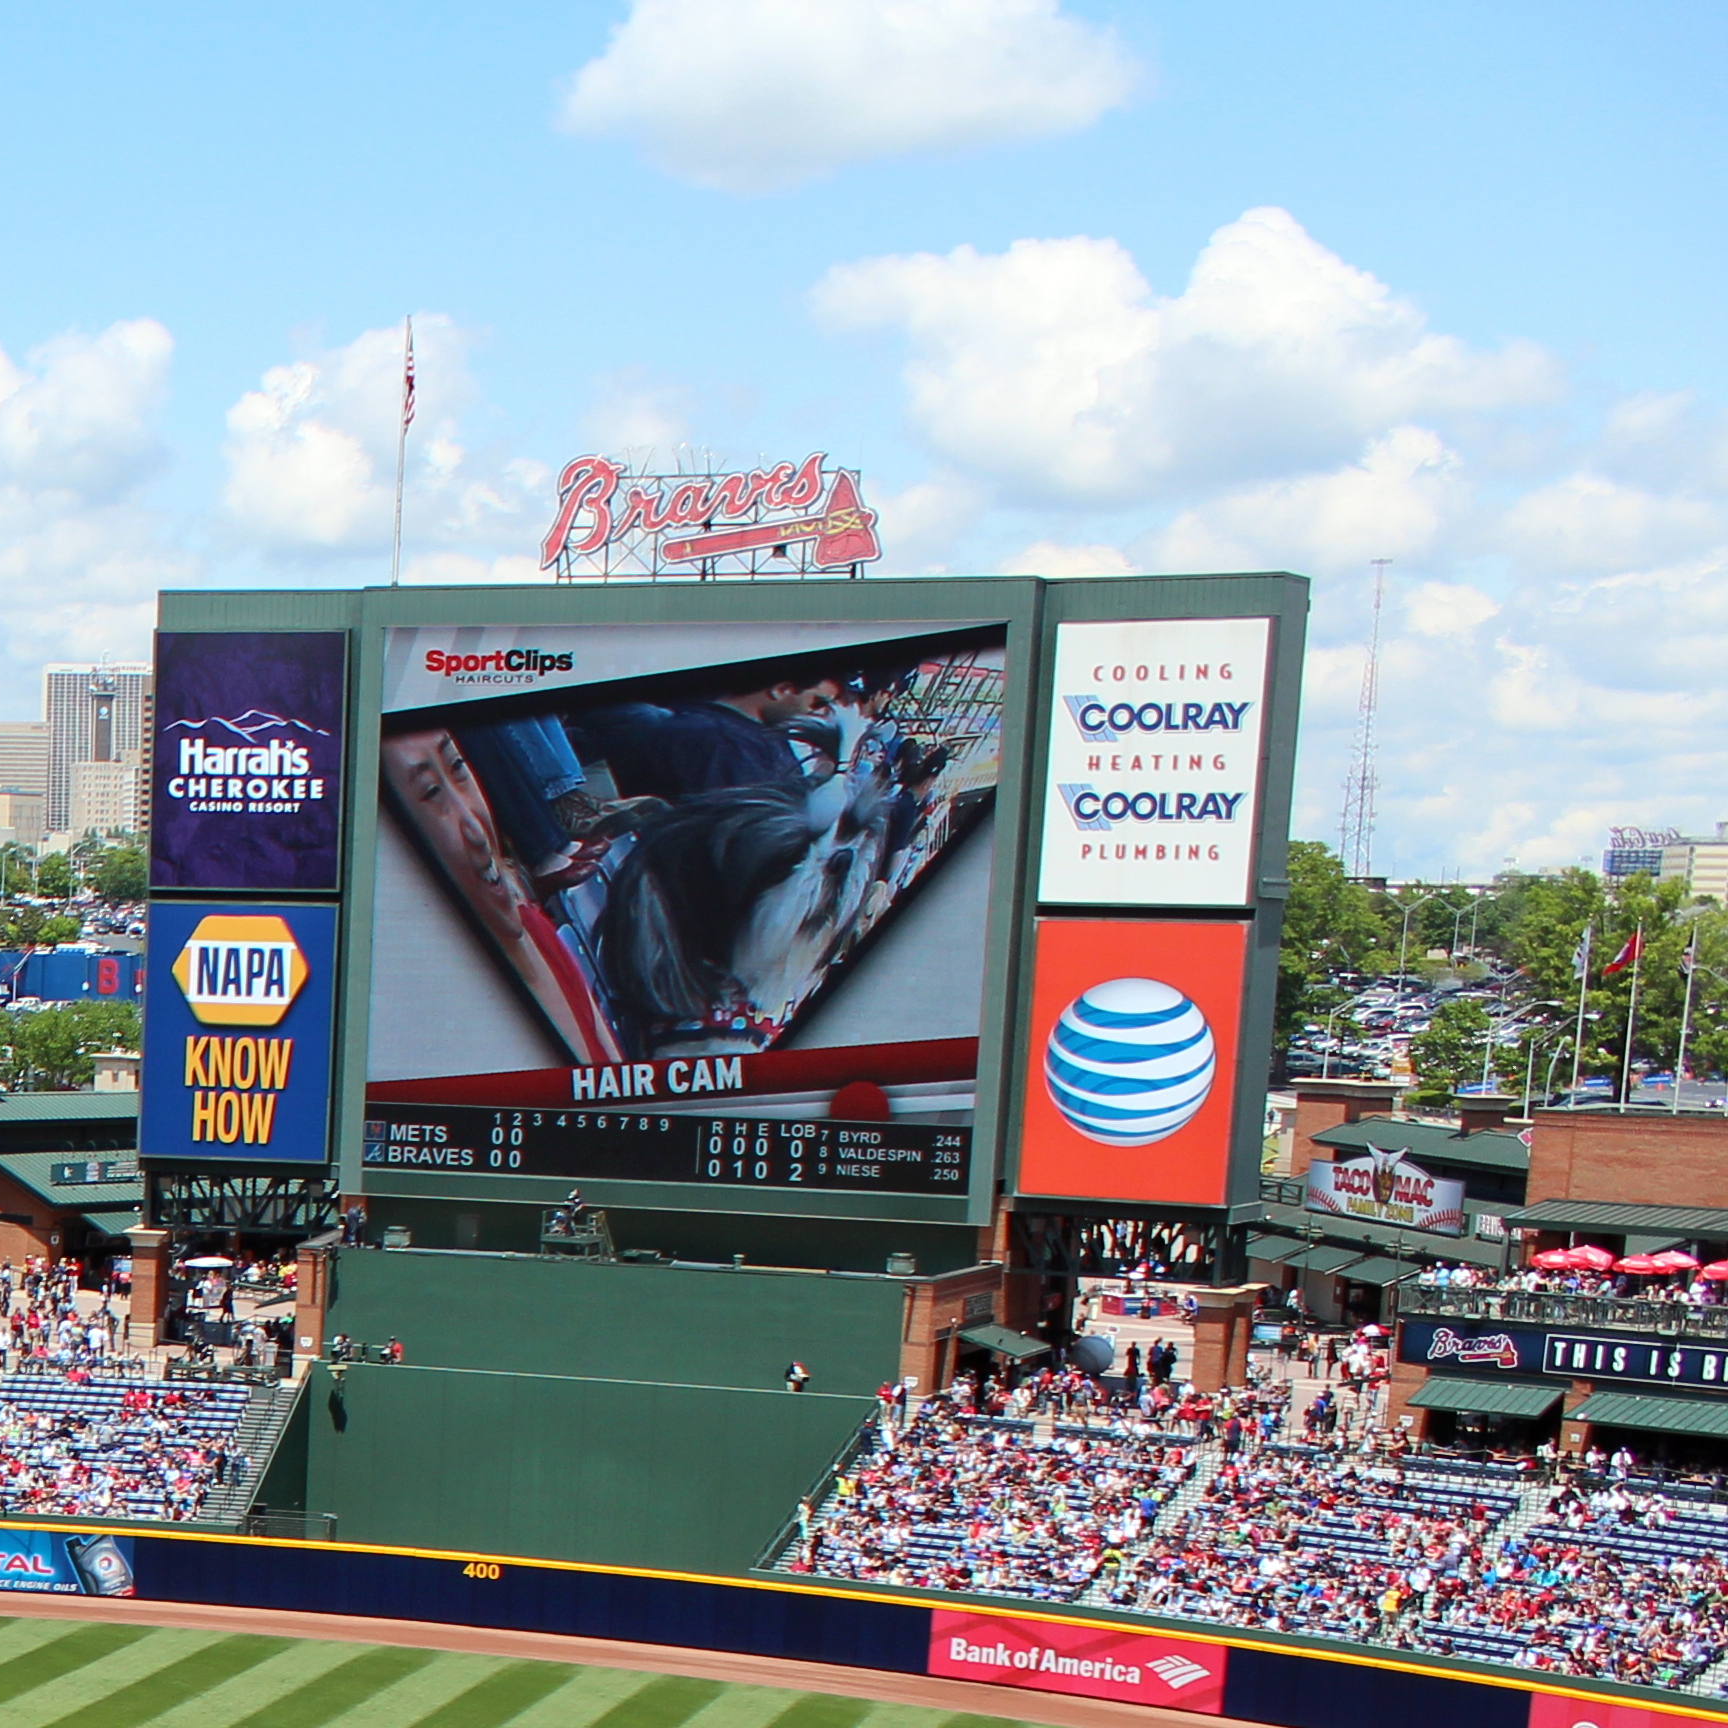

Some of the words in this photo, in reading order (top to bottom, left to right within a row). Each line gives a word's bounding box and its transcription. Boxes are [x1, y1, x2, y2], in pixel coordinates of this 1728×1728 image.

[540, 452, 828, 569] Braves
[425, 649, 574, 677] SportClips
[1092, 663, 1233, 682] COOLING
[455, 674, 534, 684] HAIRCUTS
[1079, 702, 1252, 732] COOLRAY
[179, 738, 311, 776] Harrah's
[1087, 754, 1226, 771] HEATING
[167, 777, 324, 800] CHEROKEE
[189, 801, 244, 813] CASINO
[248, 802, 301, 814] RESORT
[1073, 791, 1246, 821] COOLRAY
[1081, 843, 1220, 861] PLUMBING
[197, 946, 285, 998] NAPA
[184, 1035, 292, 1090] KNOW
[572, 1063, 656, 1101] HAIR
[667, 1056, 743, 1094] CAM
[192, 1091, 275, 1145] HOW
[712, 1121, 724, 1135] R
[735, 1122, 747, 1135] H
[758, 1123, 769, 1137] E
[780, 1123, 817, 1138] LOB
[390, 1123, 448, 1143] METS
[839, 1131, 882, 1144] BYRD
[931, 1135, 962, 1148] .244
[388, 1146, 474, 1166] BRAVES
[838, 1148, 922, 1163] VALDESPIN
[930, 1152, 961, 1164] .263
[836, 1164, 881, 1177] NIESE
[929, 1168, 960, 1180] .250
[1333, 1166, 1372, 1197] TACO
[1393, 1175, 1435, 1208] MAC
[1346, 1196, 1385, 1222] FAMILY
[1384, 1203, 1414, 1224] ZONE
[1427, 1327, 1504, 1359] Braves
[1553, 1341, 1626, 1372] THIS
[1648, 1350, 1683, 1378] IS
[462, 1562, 501, 1581] 400
[13, 1580, 51, 1591] ENGINE
[53, 1582, 78, 1592] OILS
[949, 1636, 1012, 1667] Bank
[1013, 1646, 1041, 1670] of
[1038, 1648, 1142, 1685] America
